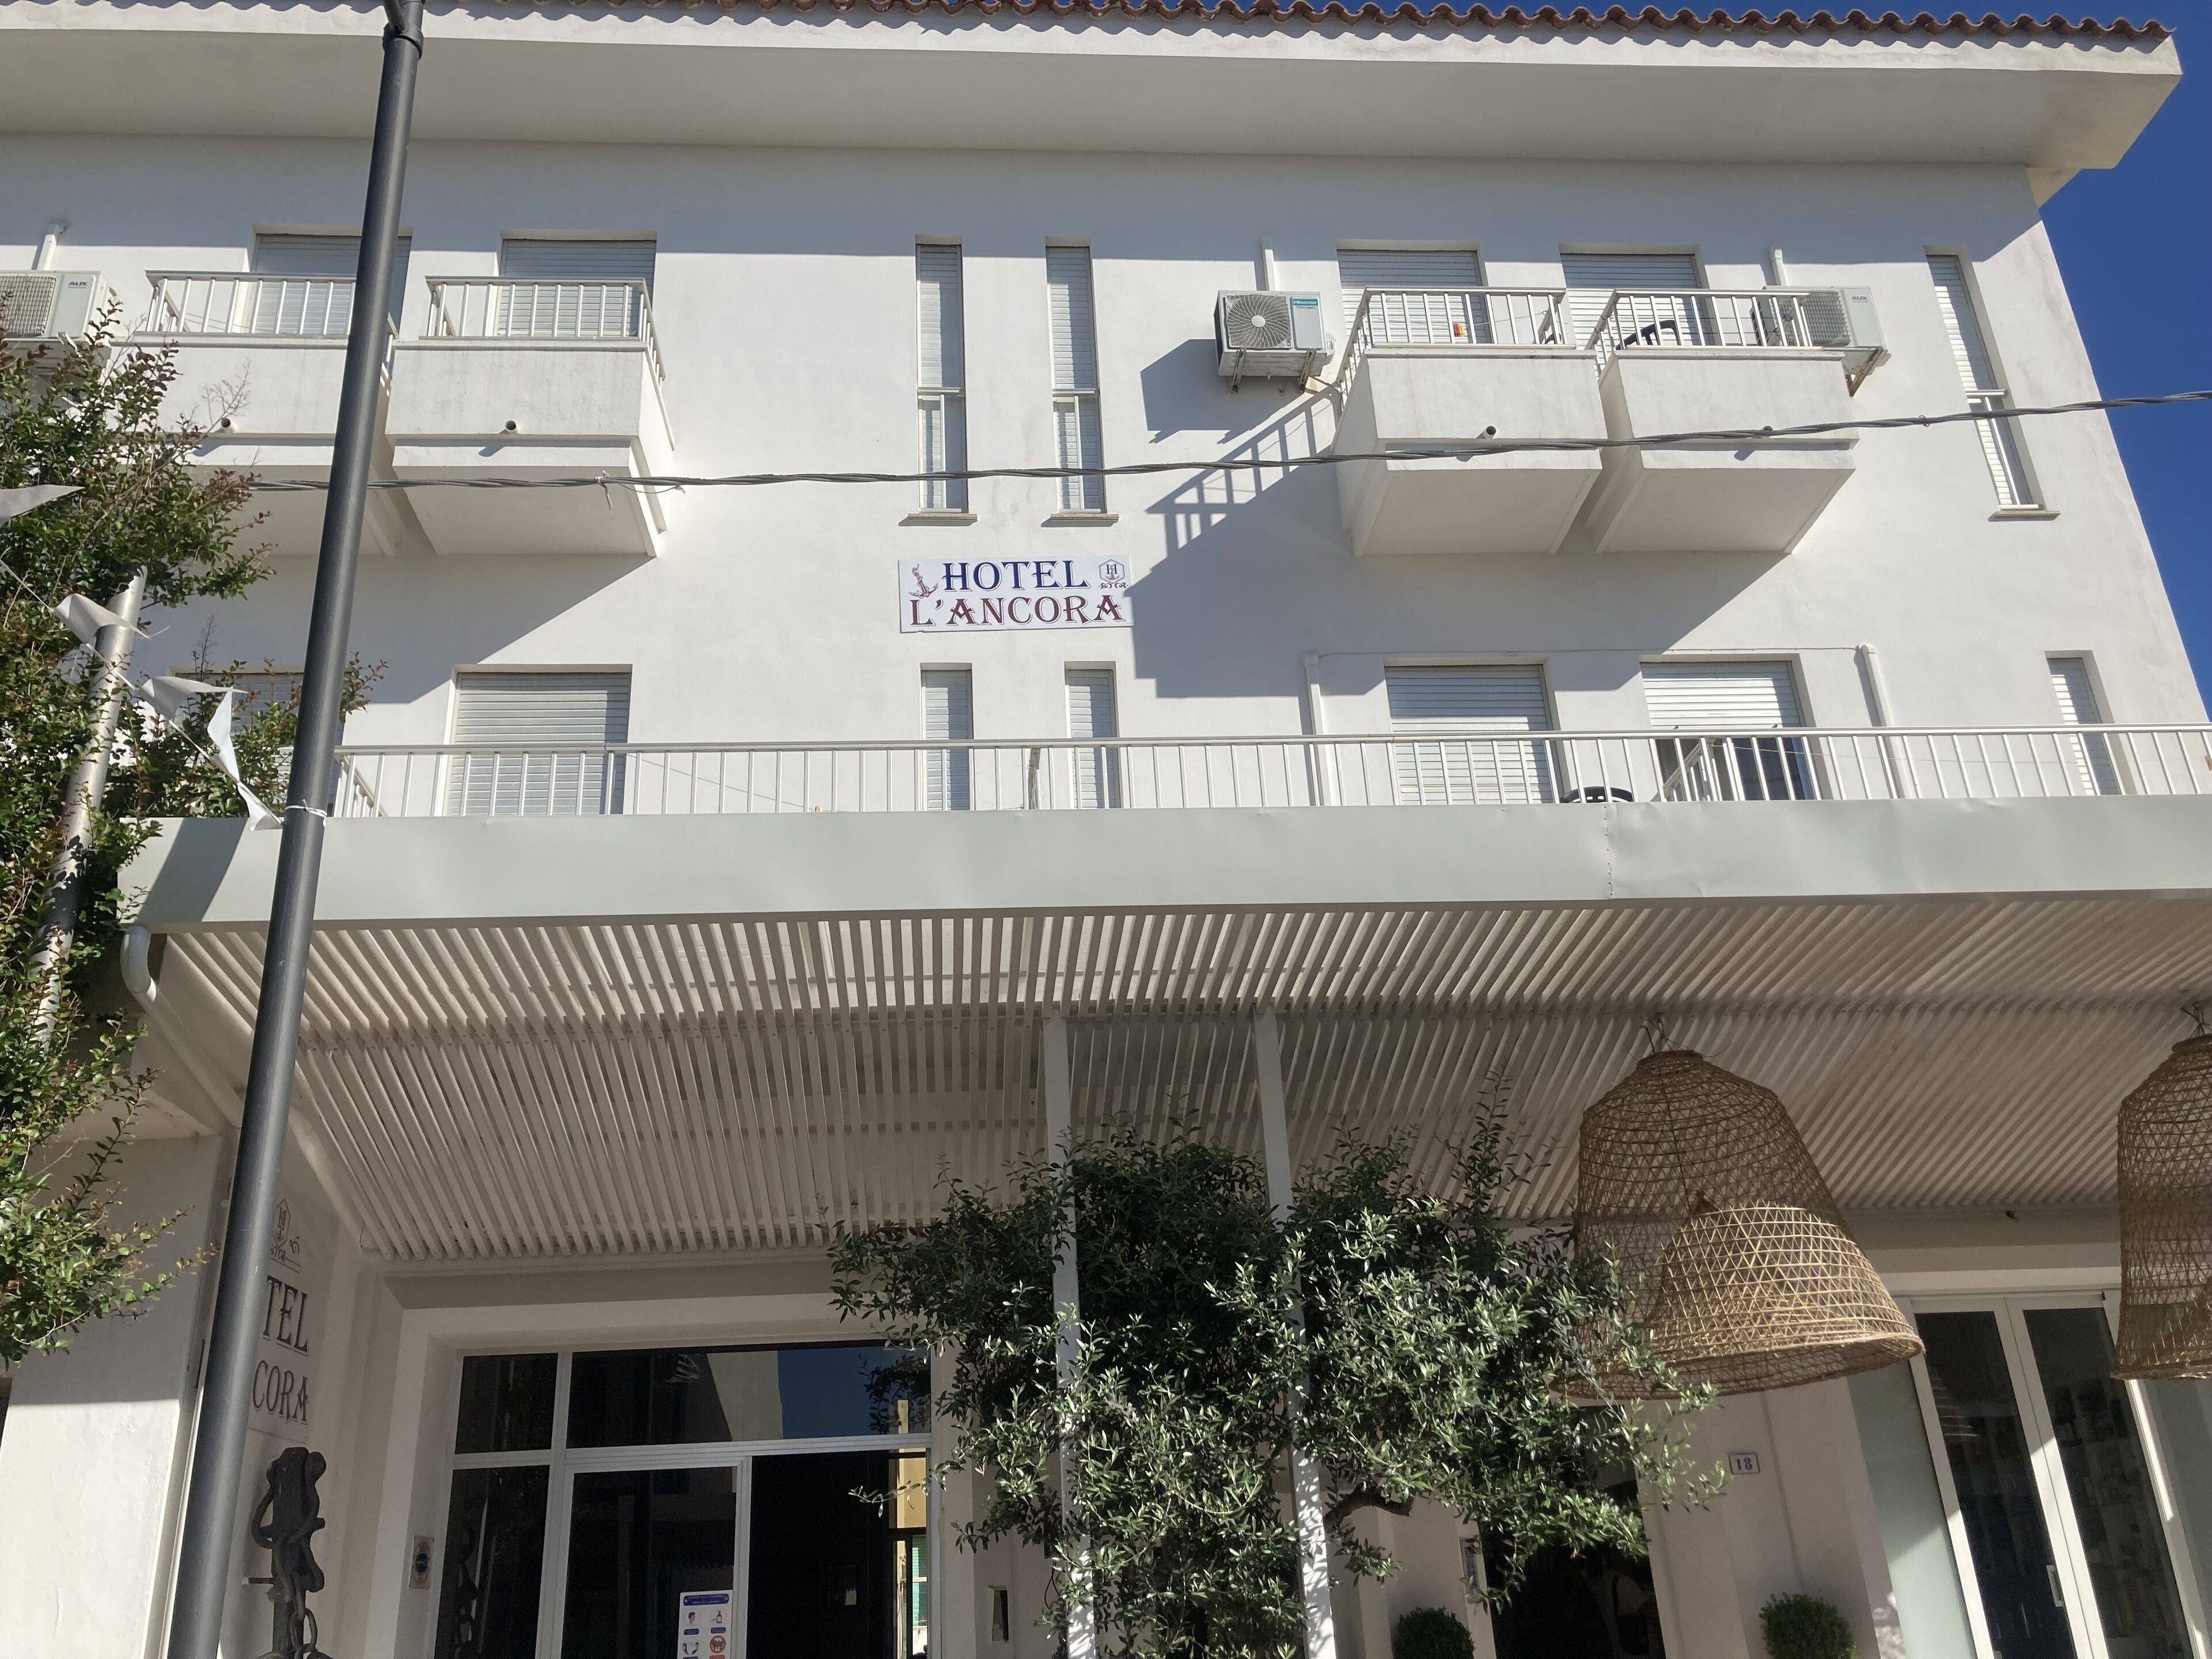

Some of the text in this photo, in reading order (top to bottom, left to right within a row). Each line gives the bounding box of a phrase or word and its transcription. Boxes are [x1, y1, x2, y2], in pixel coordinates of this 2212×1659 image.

[942, 560, 1090, 592] HOTEL
[910, 594, 1125, 626] L'ANCORA
[263, 1274, 309, 1355] TEL
[252, 1359, 309, 1425] CORA
[1736, 1457, 1753, 1471] 18
